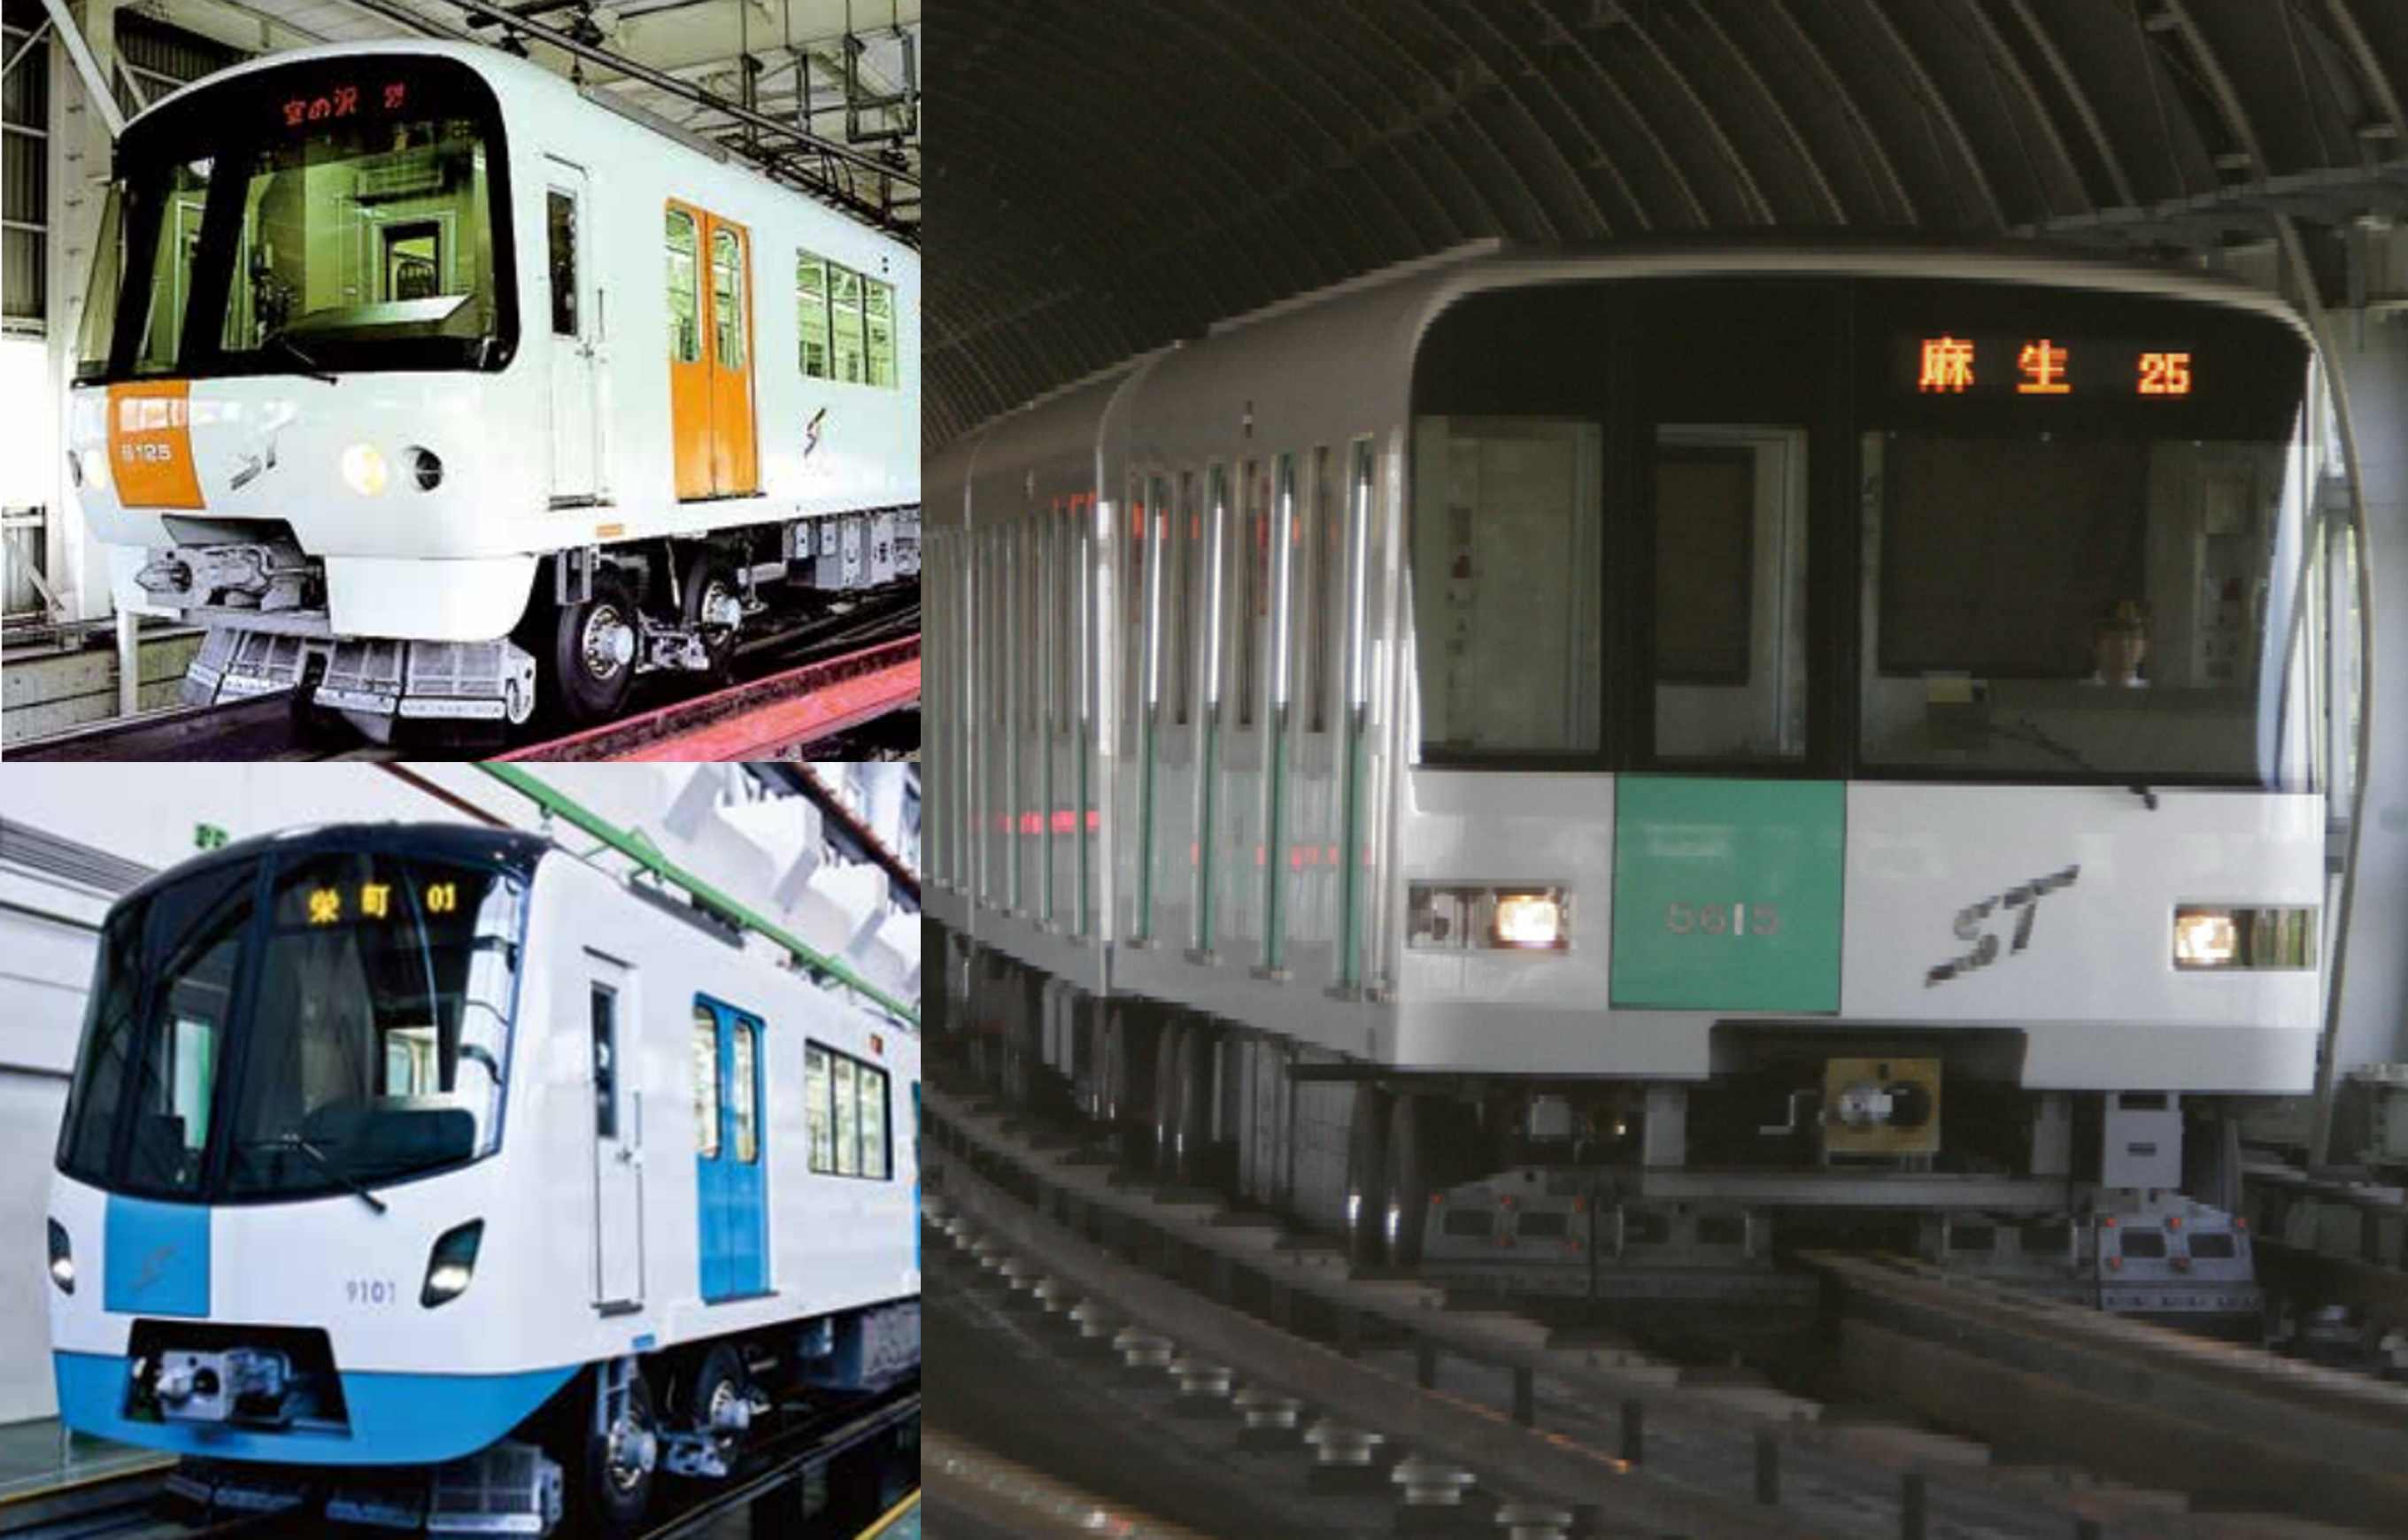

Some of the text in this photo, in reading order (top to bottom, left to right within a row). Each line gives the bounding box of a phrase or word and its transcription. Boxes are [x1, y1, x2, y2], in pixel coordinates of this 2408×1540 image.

[1919, 335, 2191, 395] 麻生 25
[310, 882, 456, 923] 栄町 01
[1666, 902, 1781, 936] 5615
[1925, 864, 2080, 989] ST
